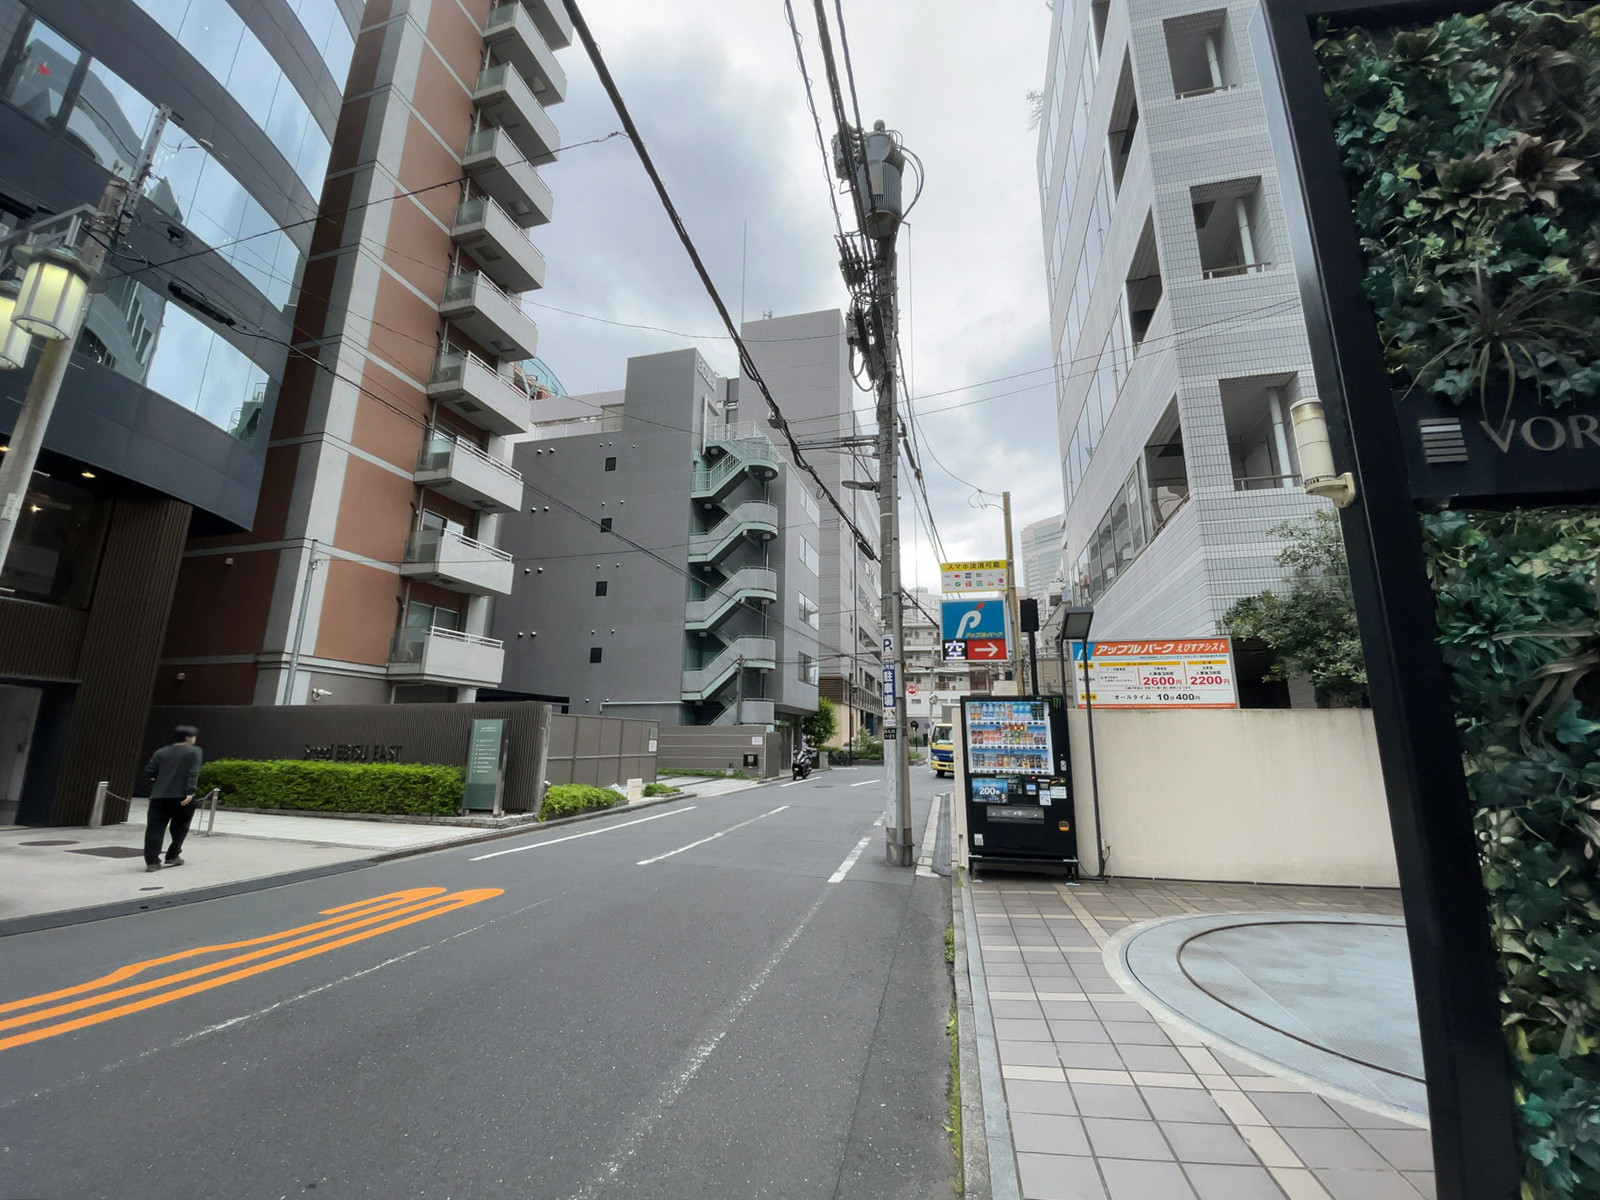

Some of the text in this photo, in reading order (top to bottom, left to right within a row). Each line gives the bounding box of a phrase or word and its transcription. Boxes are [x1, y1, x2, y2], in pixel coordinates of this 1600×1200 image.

[1478, 414, 1600, 453] VOR
[947, 561, 1001, 570] スマホ決済可能
[944, 640, 966, 660] 空
[1096, 642, 1225, 655] アップルパーク えびすアシスト
[1143, 676, 1182, 686] 2600円
[1190, 676, 1230, 685] 2200円
